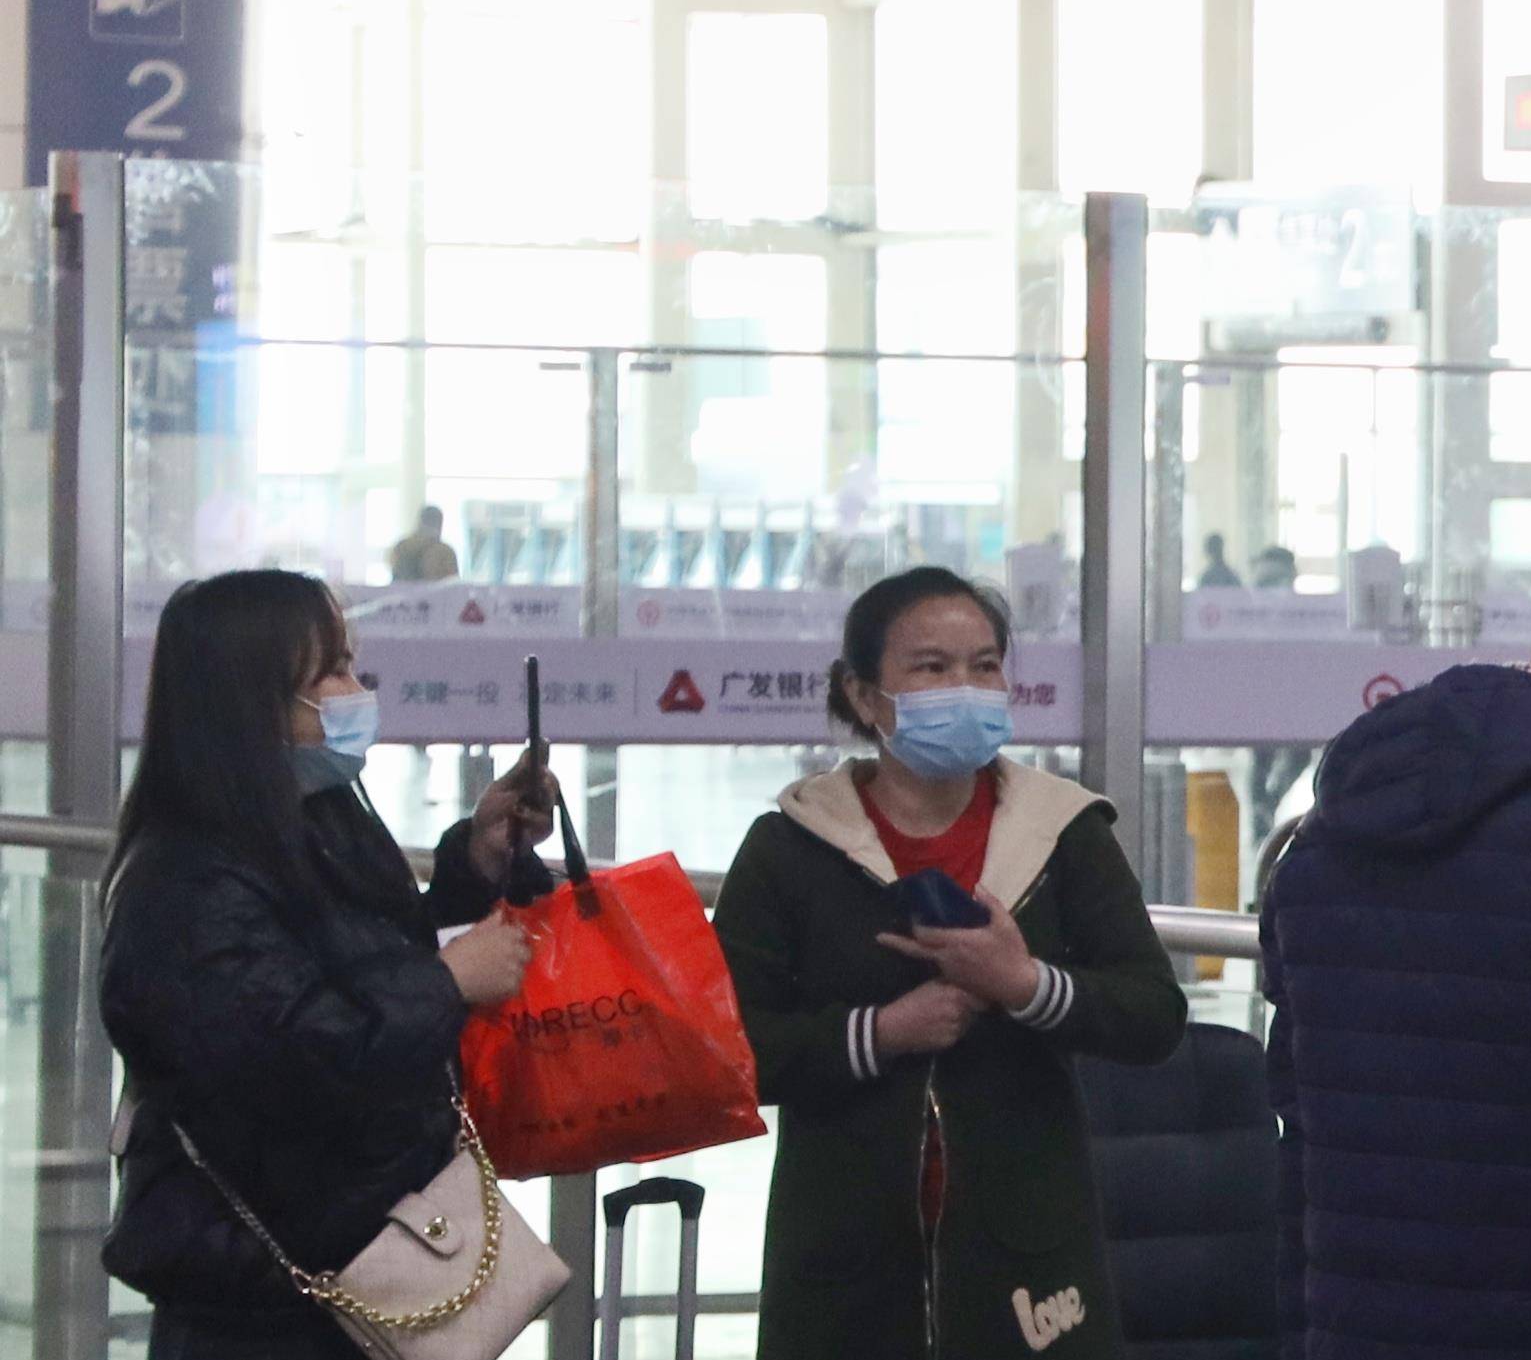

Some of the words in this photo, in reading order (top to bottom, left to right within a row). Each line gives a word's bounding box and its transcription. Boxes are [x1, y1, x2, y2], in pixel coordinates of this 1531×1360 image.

[124, 60, 187, 141] 2
[519, 679, 617, 706] 定未来
